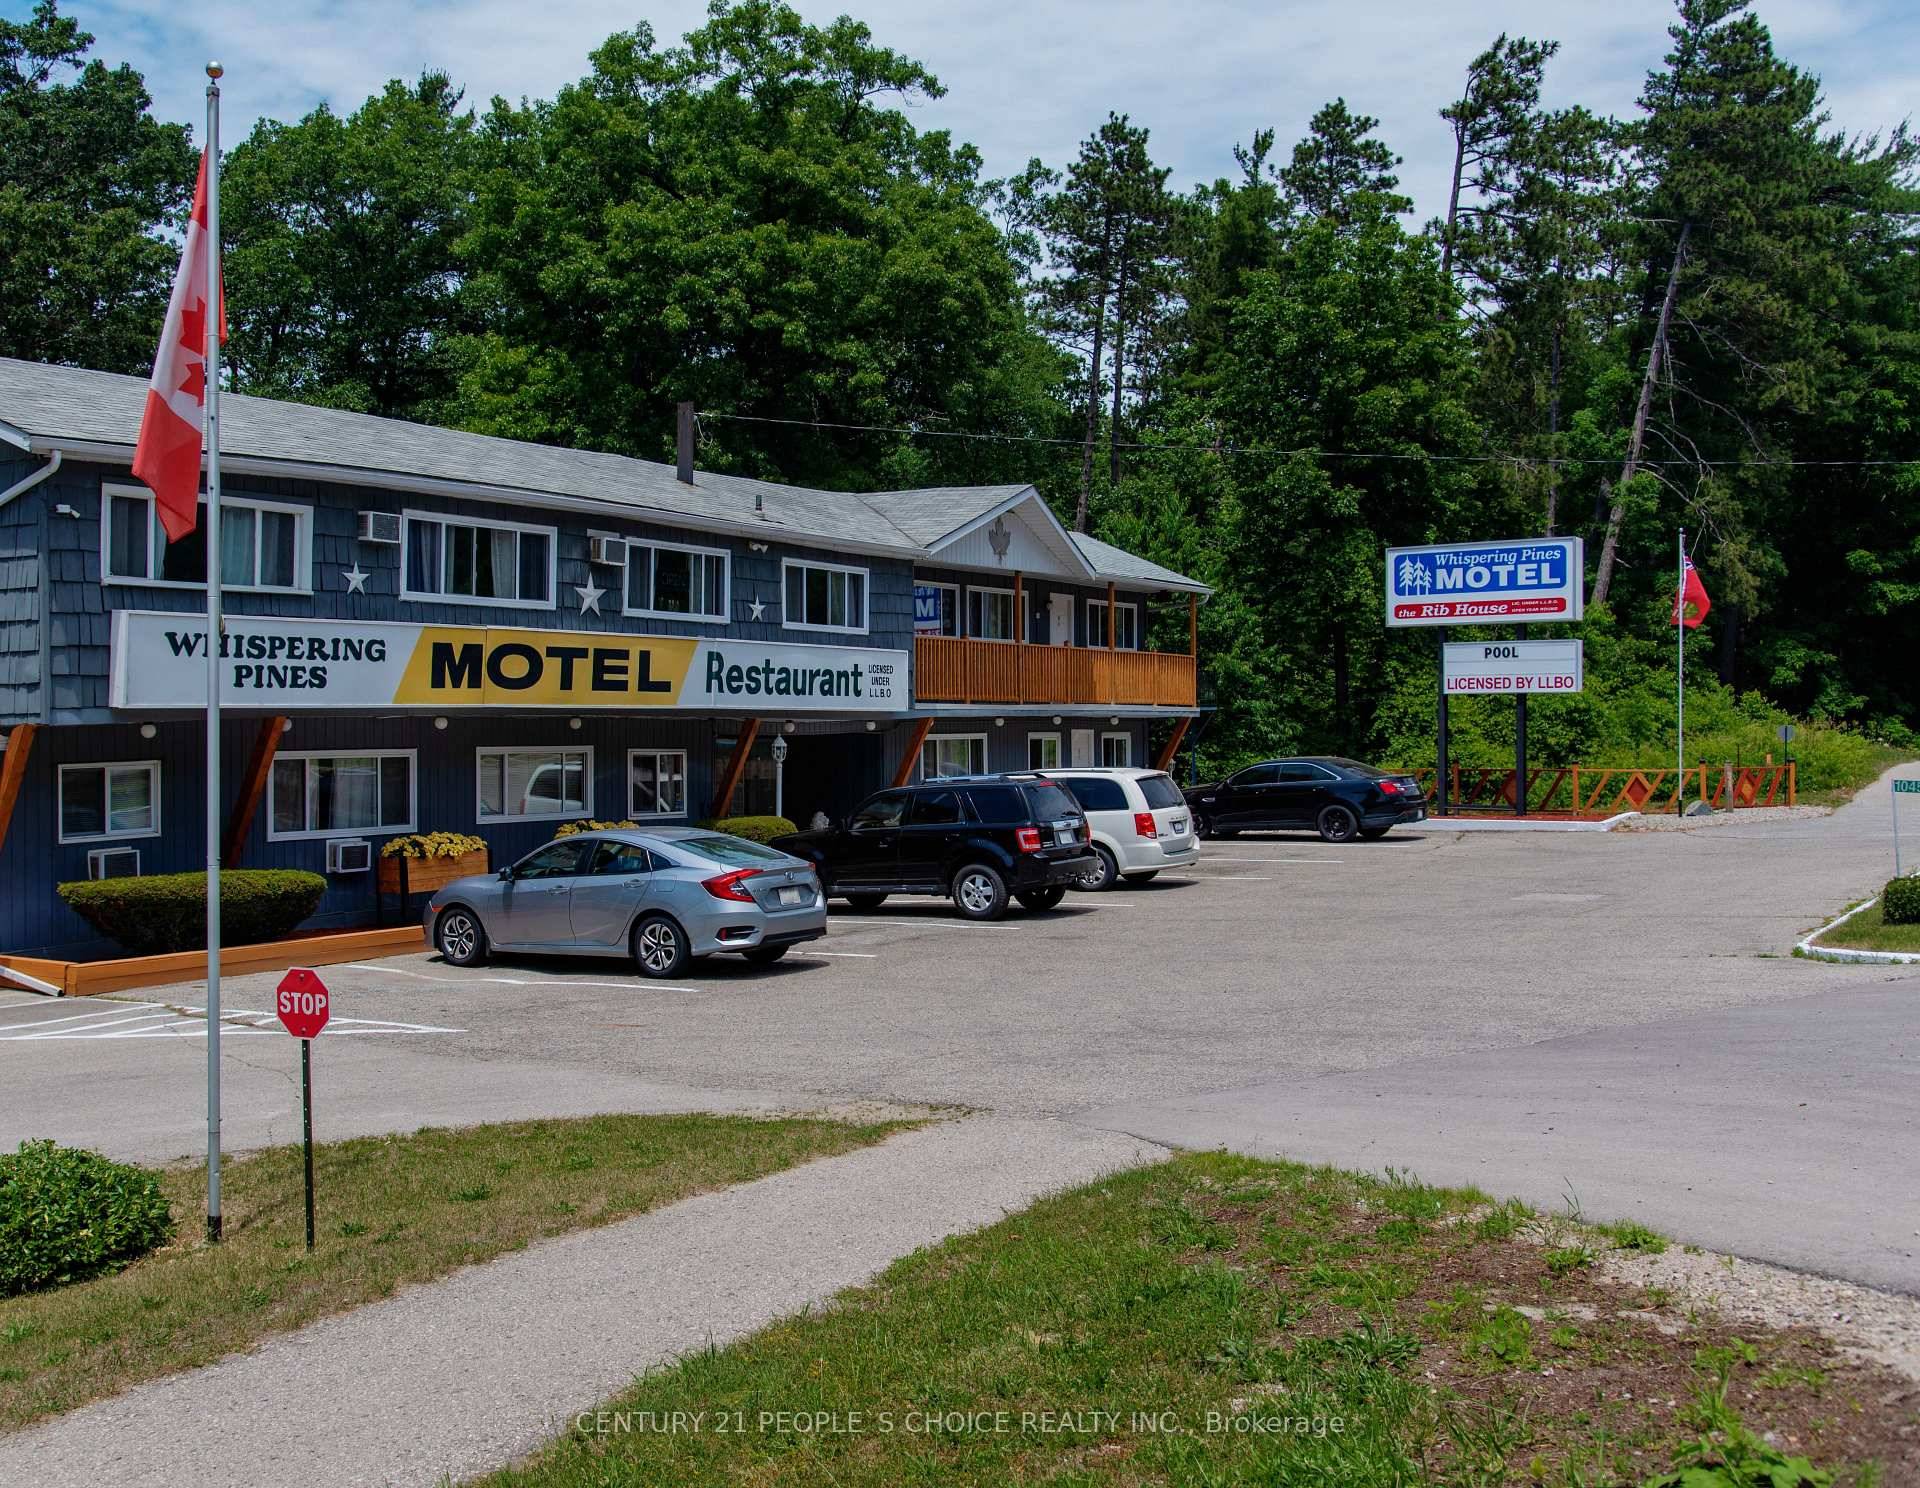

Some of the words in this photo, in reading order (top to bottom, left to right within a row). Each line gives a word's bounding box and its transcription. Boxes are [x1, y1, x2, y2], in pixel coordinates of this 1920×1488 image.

[1435, 550, 1517, 567] Whispering
[1521, 548, 1561, 561] Pines
[1436, 563, 1560, 589] MOTEL
[1398, 609, 1416, 618] the
[1420, 604, 1449, 617] Rib
[1453, 603, 1508, 616] House
[164, 631, 386, 662] WHISPERING
[1484, 646, 1519, 659] POOL
[233, 664, 328, 689] PINES
[431, 642, 672, 692] MOTEL
[705, 651, 863, 697] Restaurant
[868, 664, 894, 675] LICENSED
[871, 676, 890, 686] UNDER
[1447, 677, 1511, 690] LICENSED
[1516, 676, 1534, 689] BY
[1538, 676, 1574, 689] LLBO
[280, 991, 326, 1016] STOP
